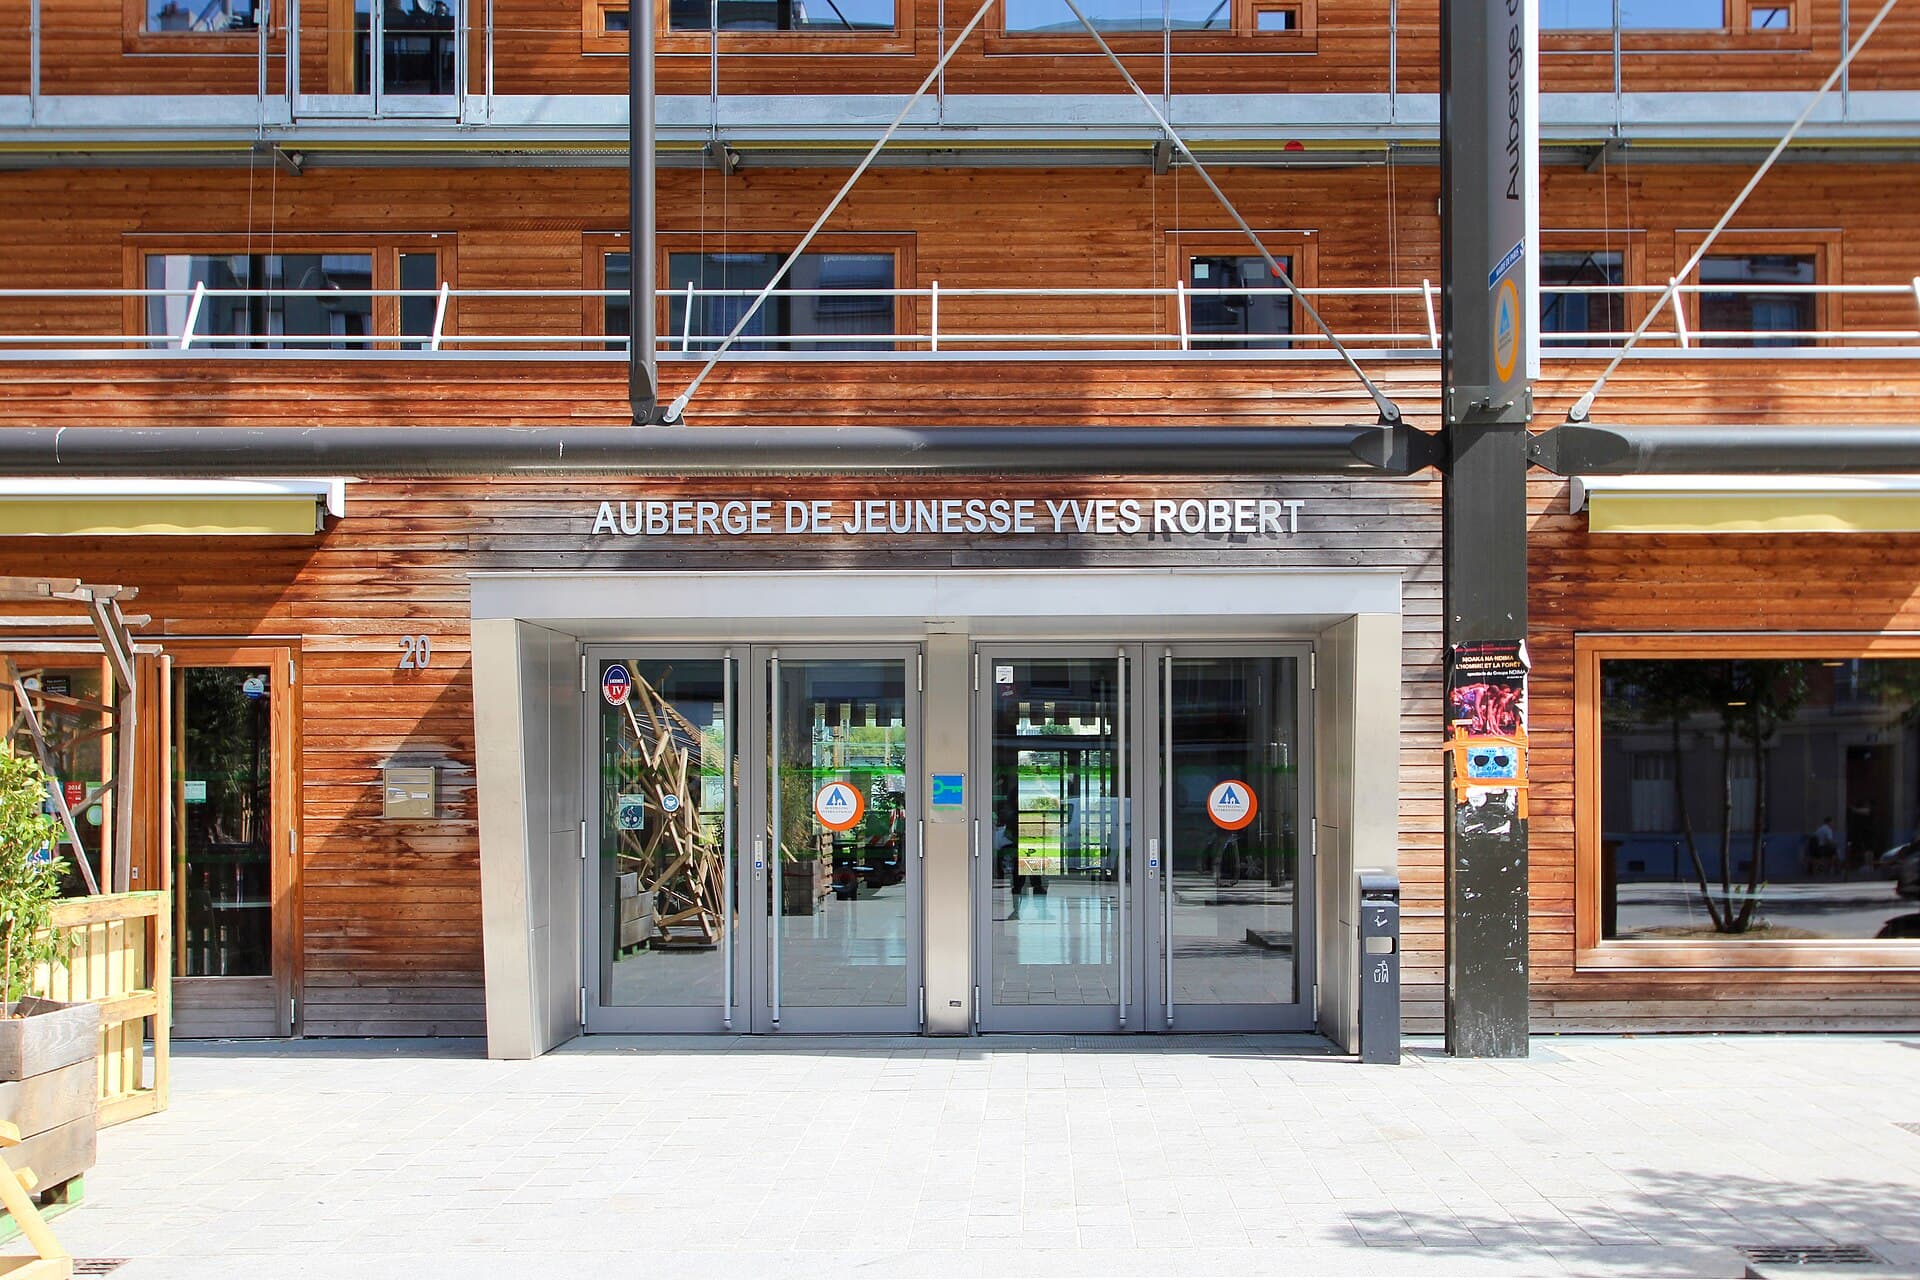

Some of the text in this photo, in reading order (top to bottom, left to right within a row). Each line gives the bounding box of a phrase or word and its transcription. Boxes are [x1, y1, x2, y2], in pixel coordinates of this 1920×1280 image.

[1506, 24, 1522, 200] Auberge
[592, 498, 1305, 536] AUBERGE DE JEUNESSE YVES ROBERT
[399, 634, 431, 669] 20
[612, 686, 623, 695] IV
